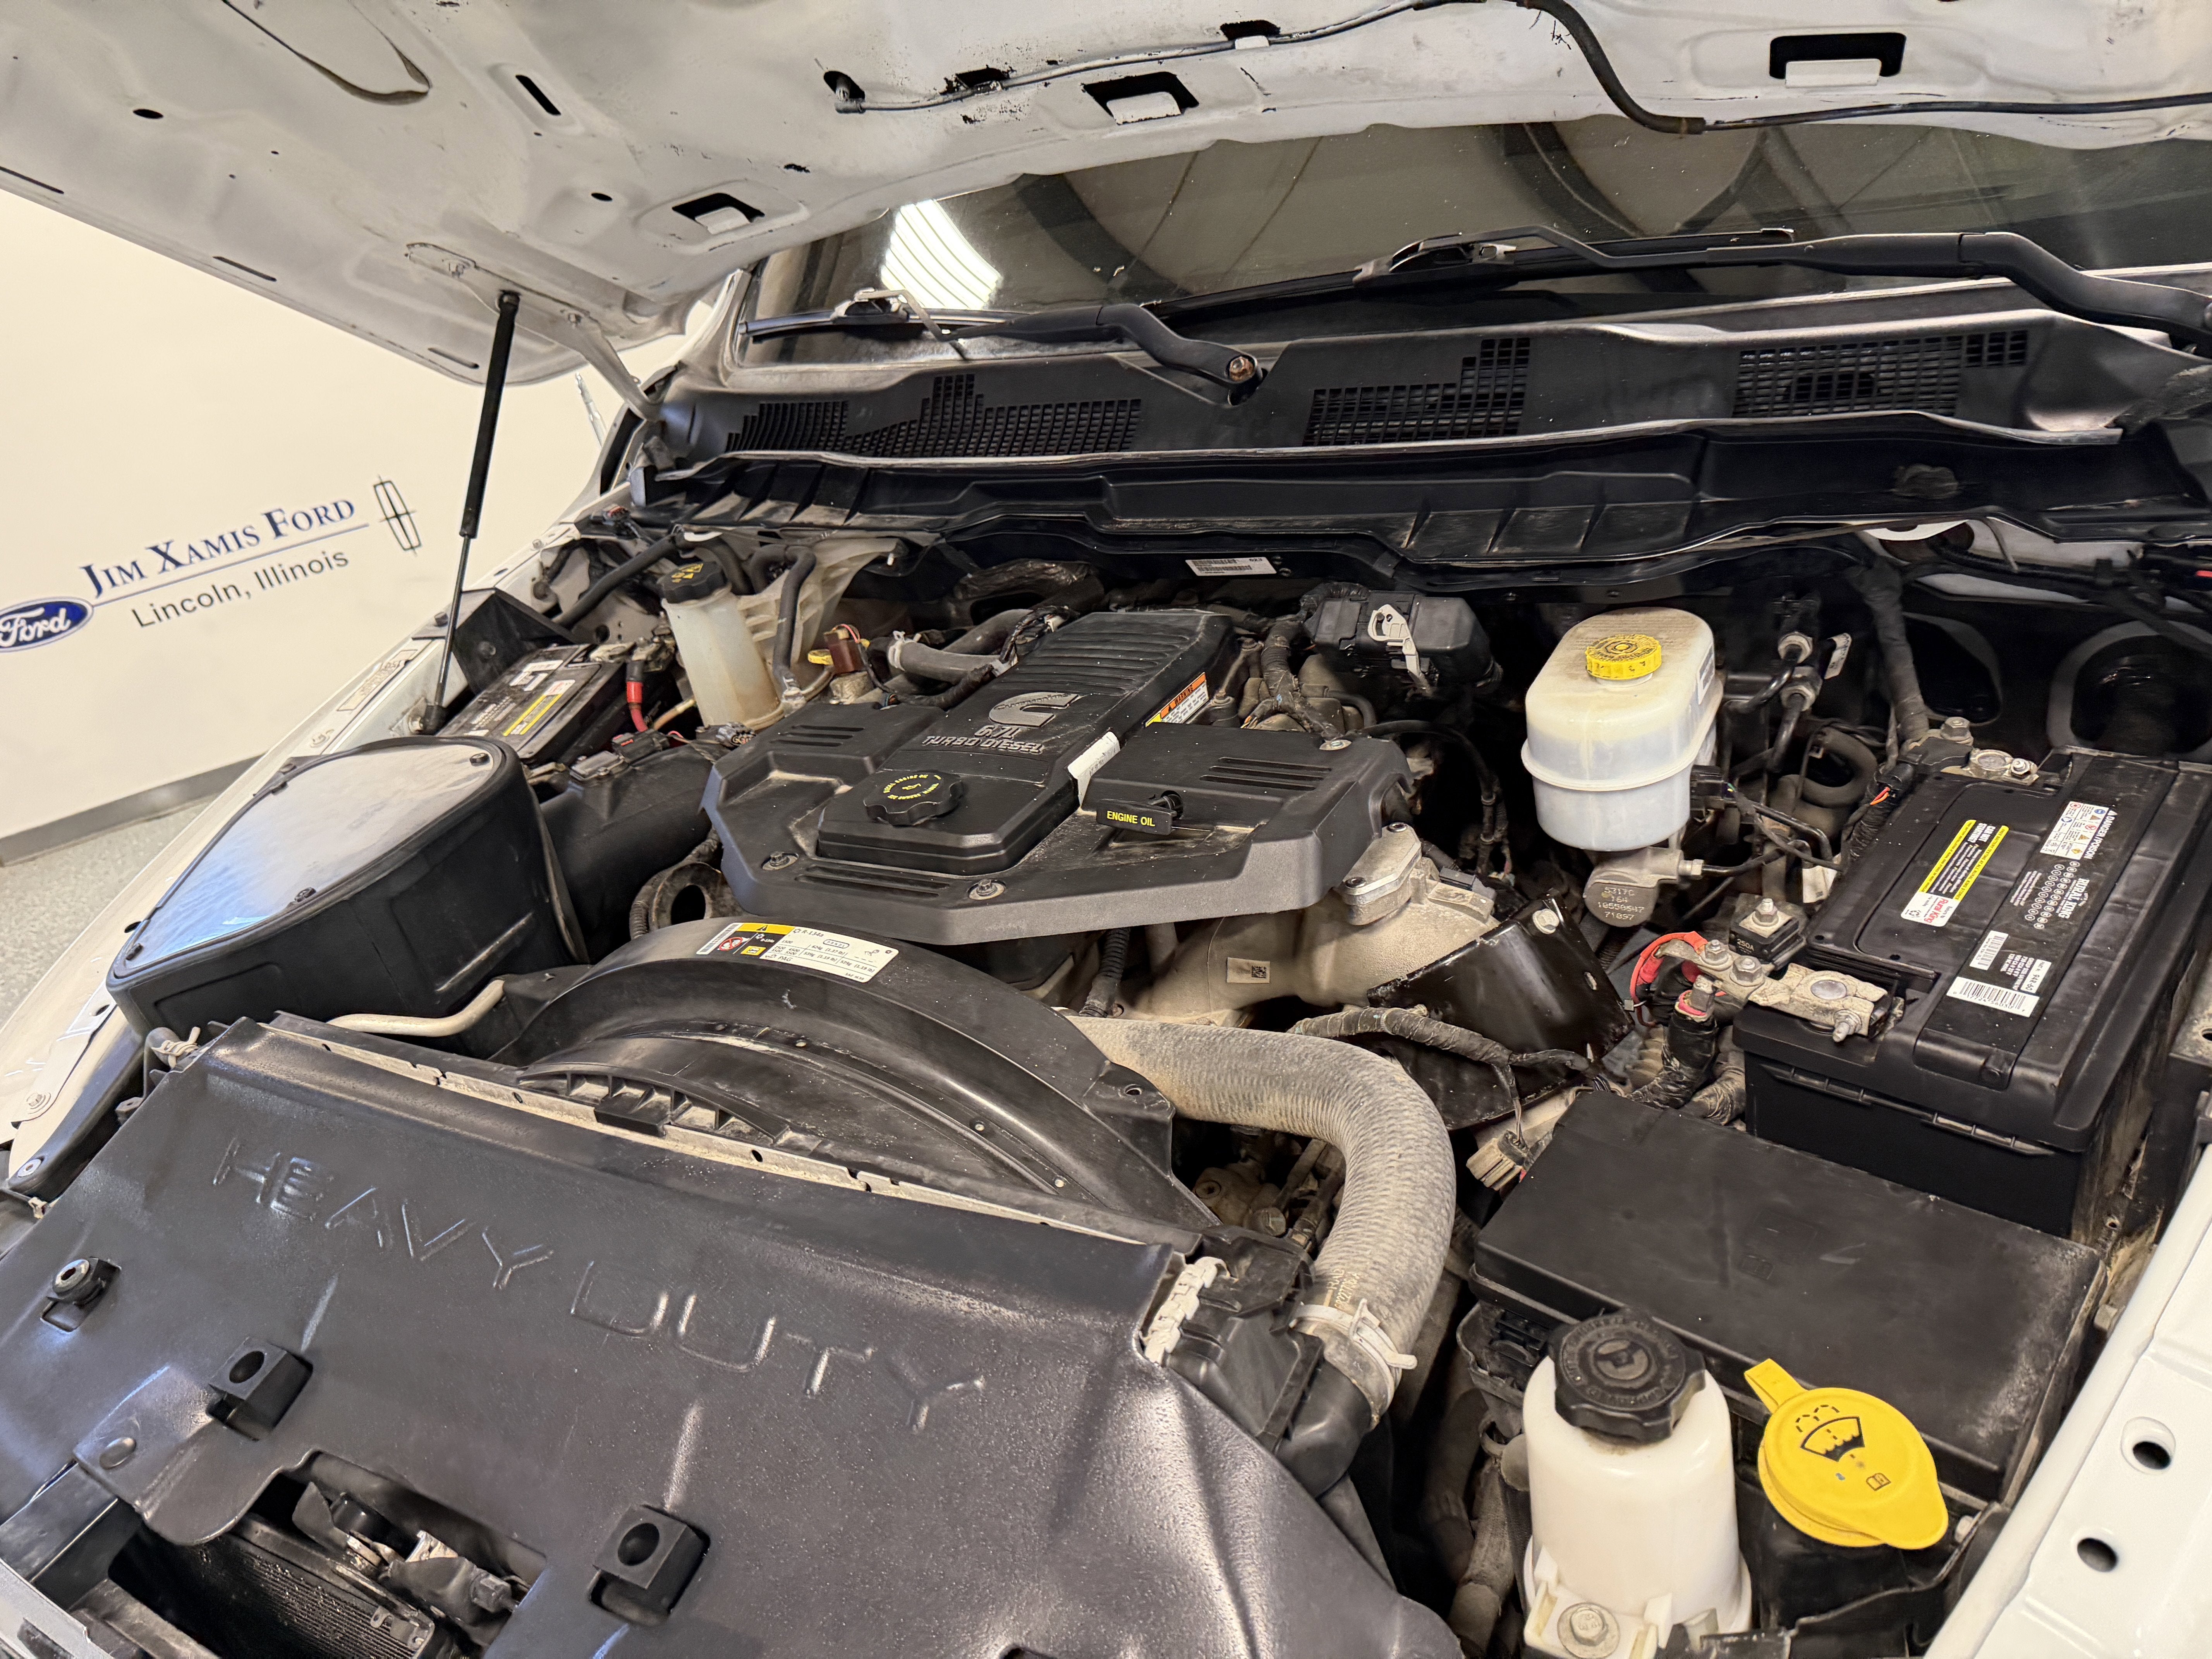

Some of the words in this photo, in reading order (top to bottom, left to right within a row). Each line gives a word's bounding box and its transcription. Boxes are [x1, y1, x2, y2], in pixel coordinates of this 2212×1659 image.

[130, 582, 252, 629] Lincoln,
[253, 548, 350, 592] Illinois
[0, 607, 71, 647] Ford
[922, 735, 981, 747] TURBO
[980, 738, 1045, 754] DIESEL
[1106, 811, 1138, 824] ENGINE
[1140, 817, 1156, 827] OIL
[2068, 878, 2090, 900] RURAL
[2058, 900, 2077, 919] KING
[1737, 939, 1754, 951] 250A
